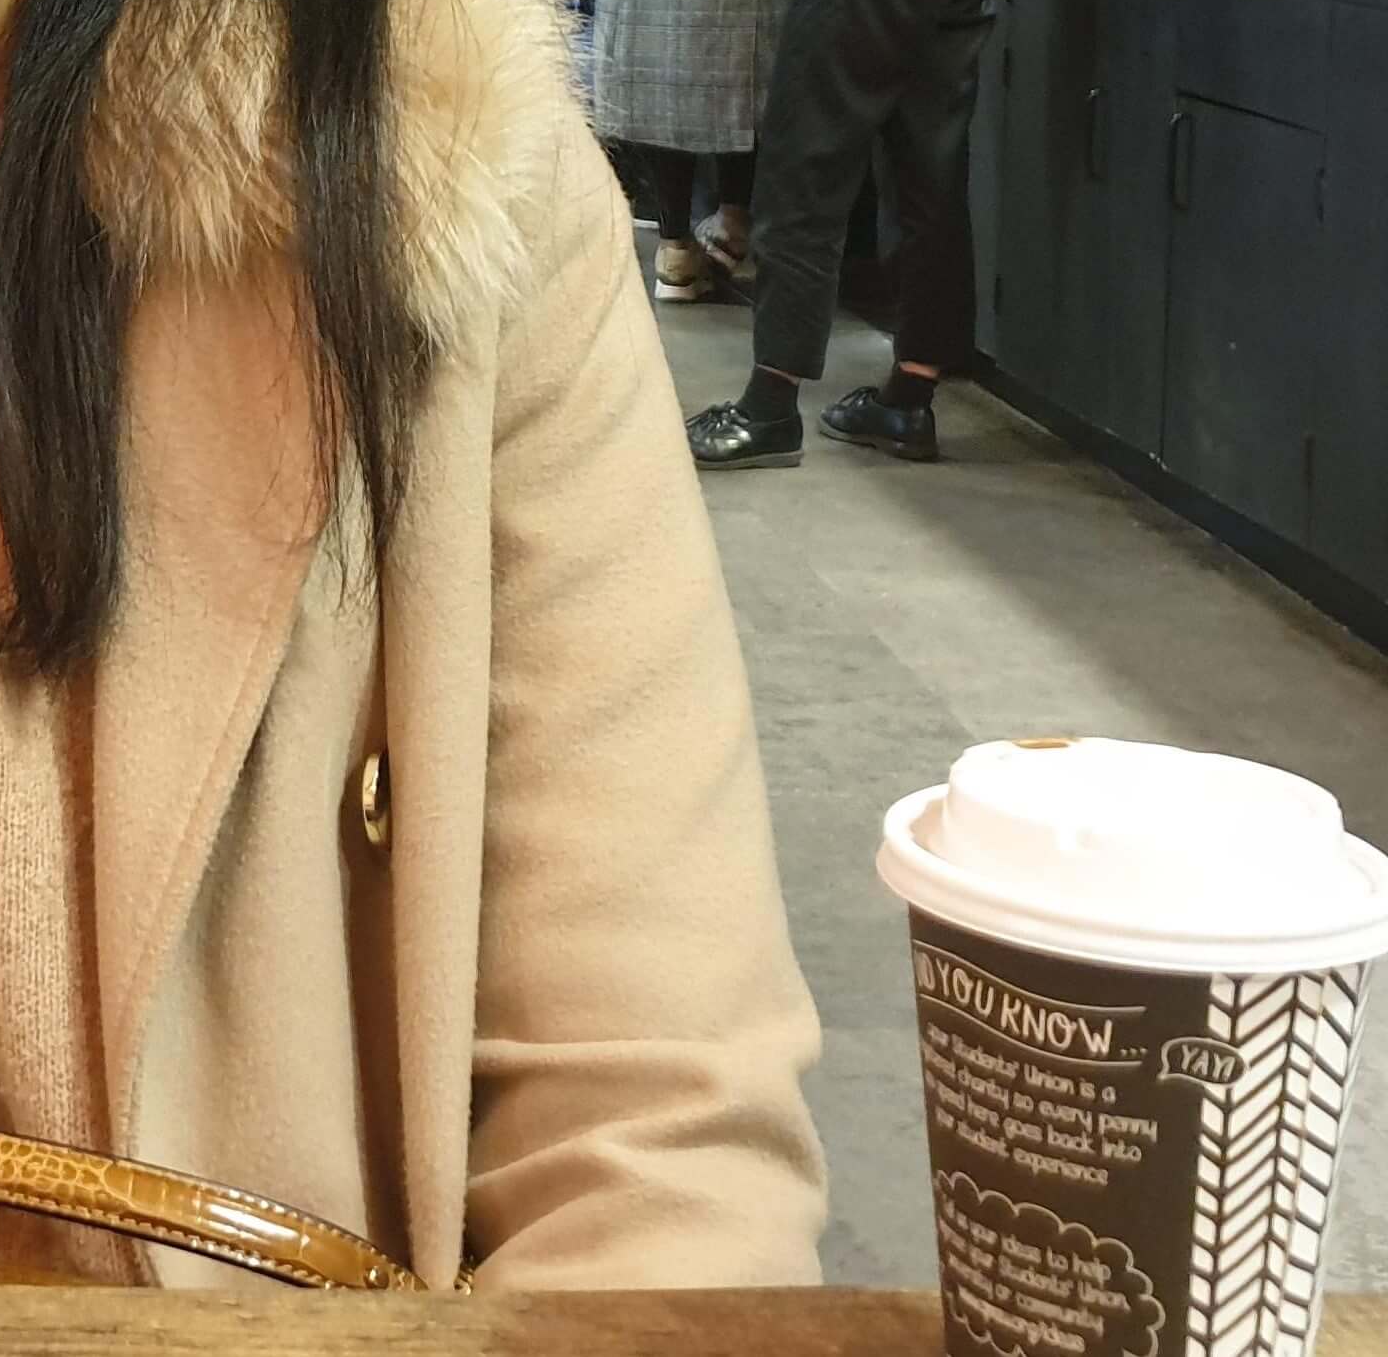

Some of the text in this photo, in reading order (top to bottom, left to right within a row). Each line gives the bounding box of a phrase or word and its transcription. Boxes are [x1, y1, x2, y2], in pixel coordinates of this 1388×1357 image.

[935, 956, 995, 1018] YOU
[1024, 1062, 1075, 1096] Union
[1079, 1077, 1096, 1100] is
[1101, 1085, 1117, 1104] a
[1038, 1100, 1093, 1134] every
[1098, 1112, 1158, 1144] penny
[1047, 1123, 1096, 1155] back
[1101, 1136, 1142, 1162] into
[1046, 1245, 1069, 1272] to
[1072, 1250, 1112, 1291] help
